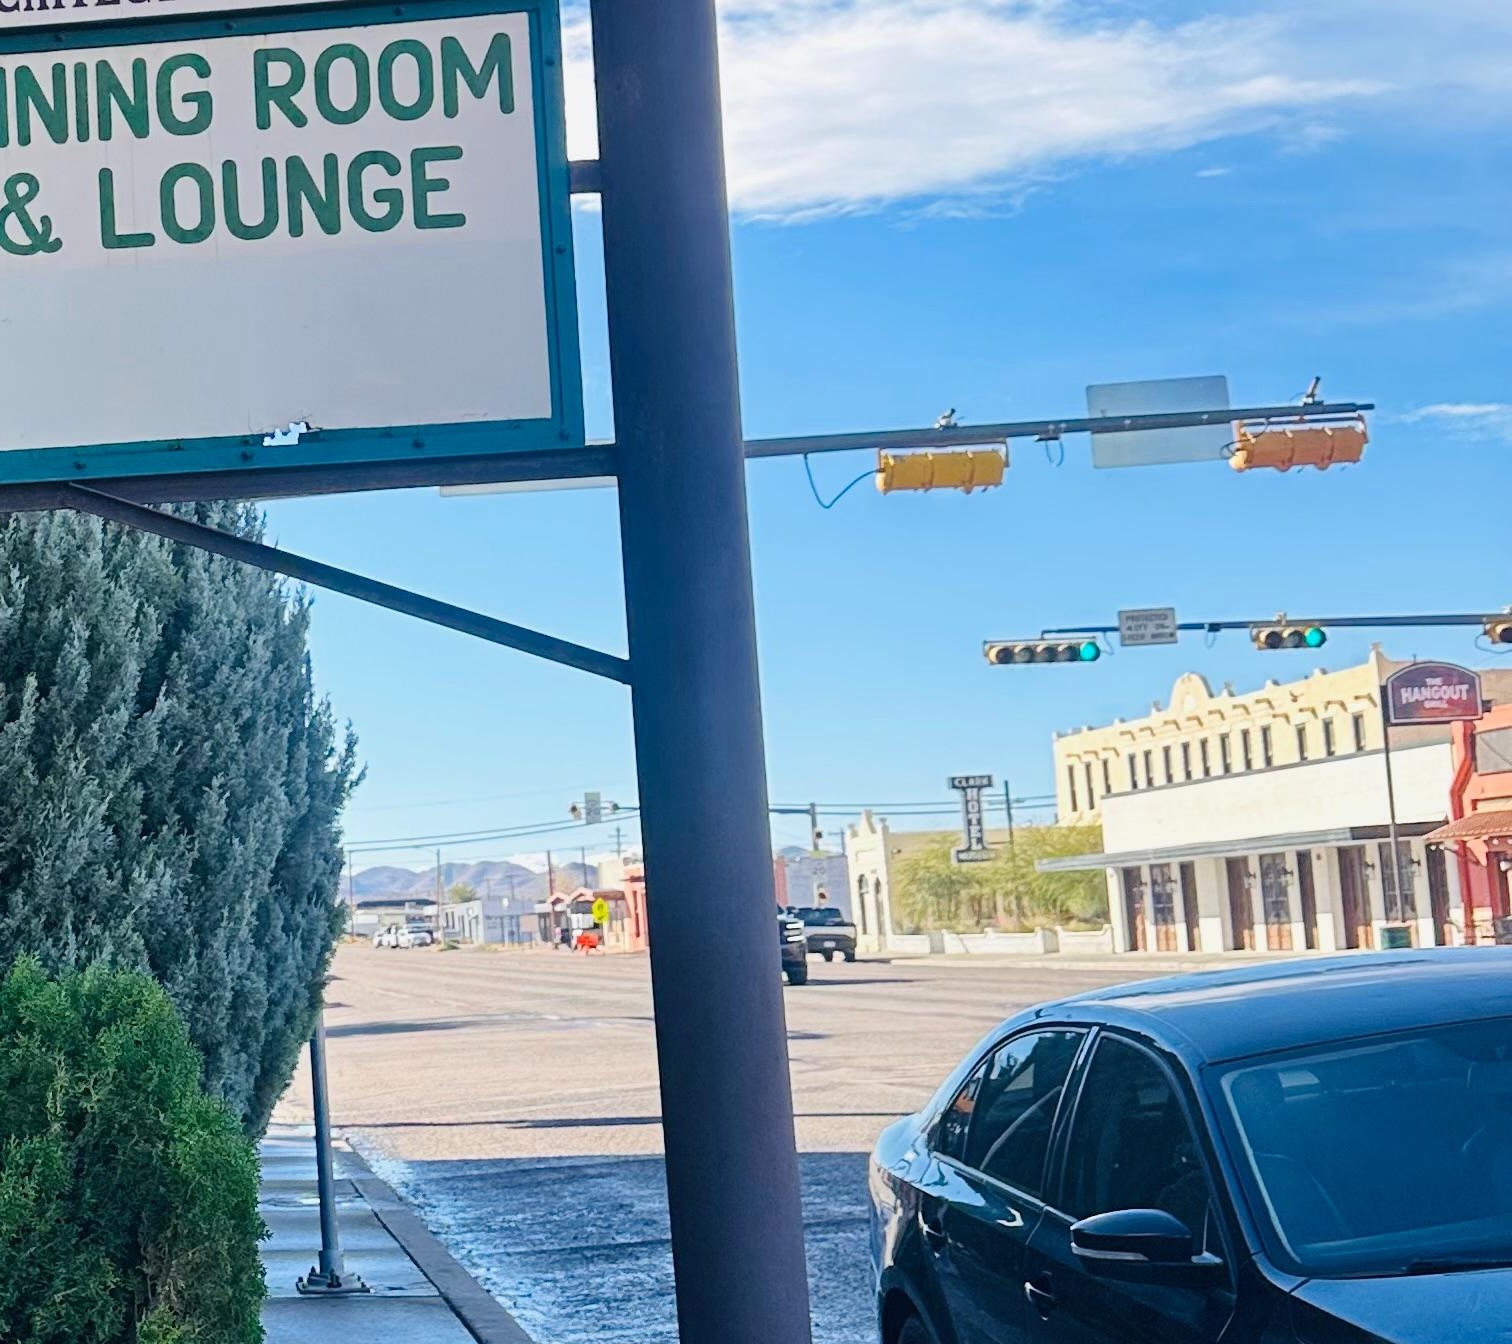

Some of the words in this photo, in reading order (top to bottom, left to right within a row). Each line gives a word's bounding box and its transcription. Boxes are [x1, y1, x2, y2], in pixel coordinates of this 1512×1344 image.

[253, 33, 516, 130] ROOM
[97, 145, 467, 249] LOUNGE
[1400, 684, 1470, 704] HANGOUT
[1425, 677, 1444, 686] THE
[966, 788, 983, 850] HOTEL
